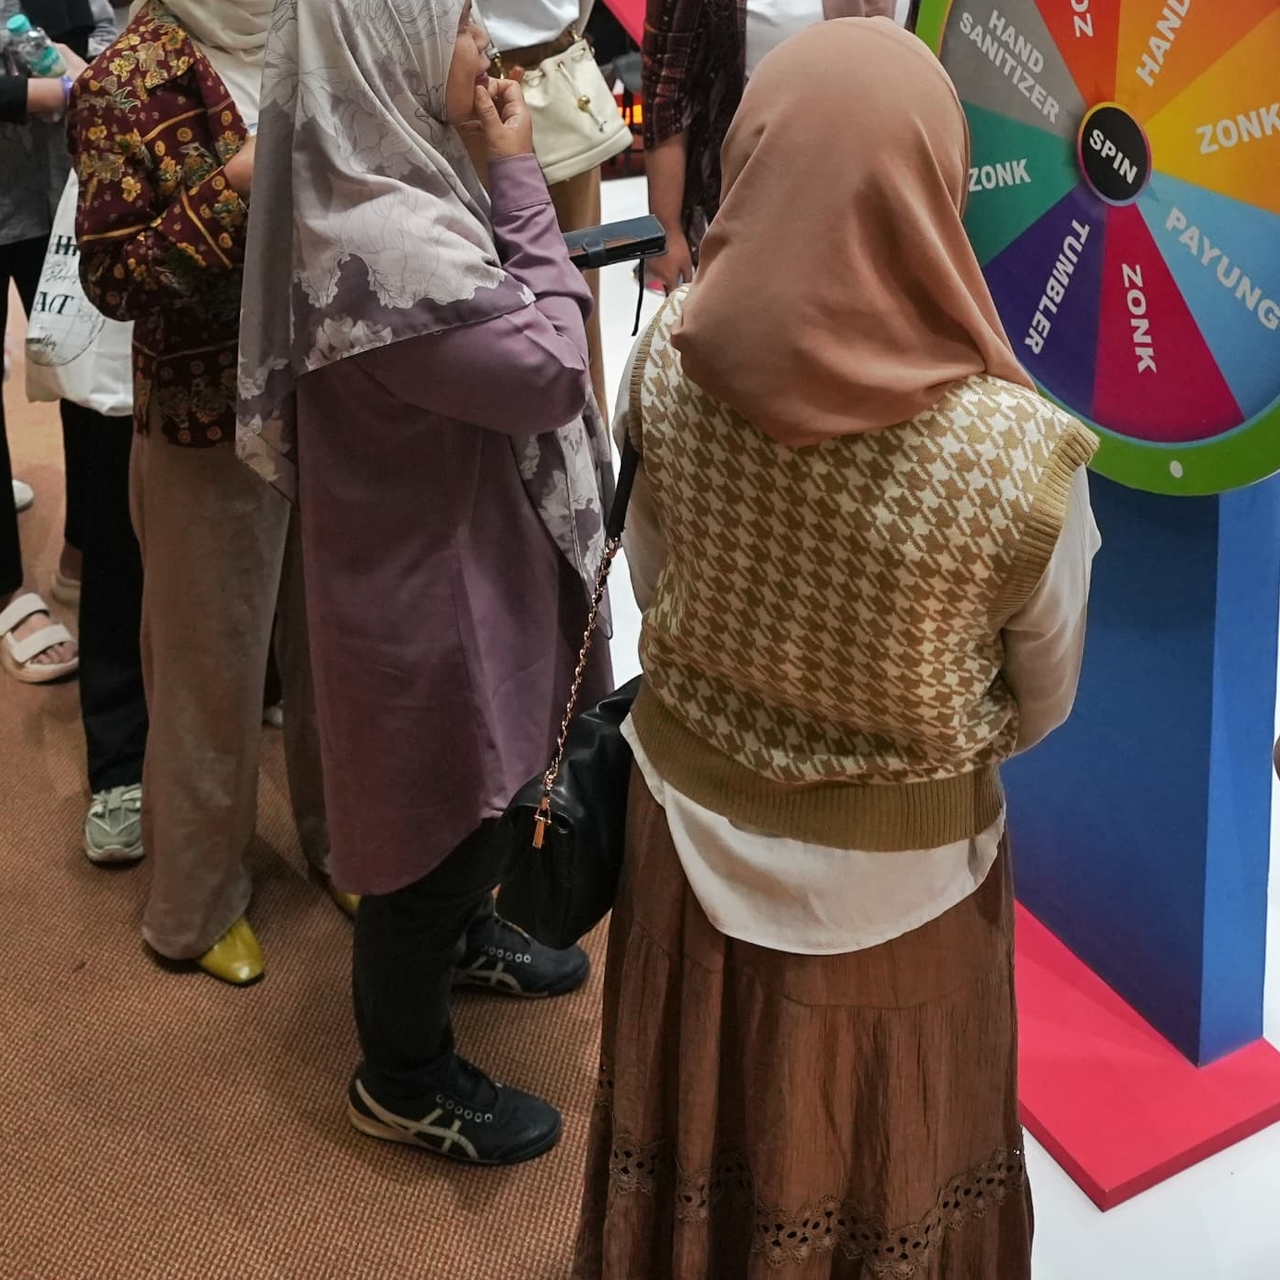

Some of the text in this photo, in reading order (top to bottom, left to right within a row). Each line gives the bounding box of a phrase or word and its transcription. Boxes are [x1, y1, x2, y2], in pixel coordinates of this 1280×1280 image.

[960, 12, 1060, 124] SANITIZER
[989, 9, 1044, 74] HAND
[968, 158, 1032, 193] ZONK
[1089, 128, 1138, 184] SPIN
[1024, 219, 1091, 355] TUMBLER
[1121, 263, 1157, 374] ZONK
